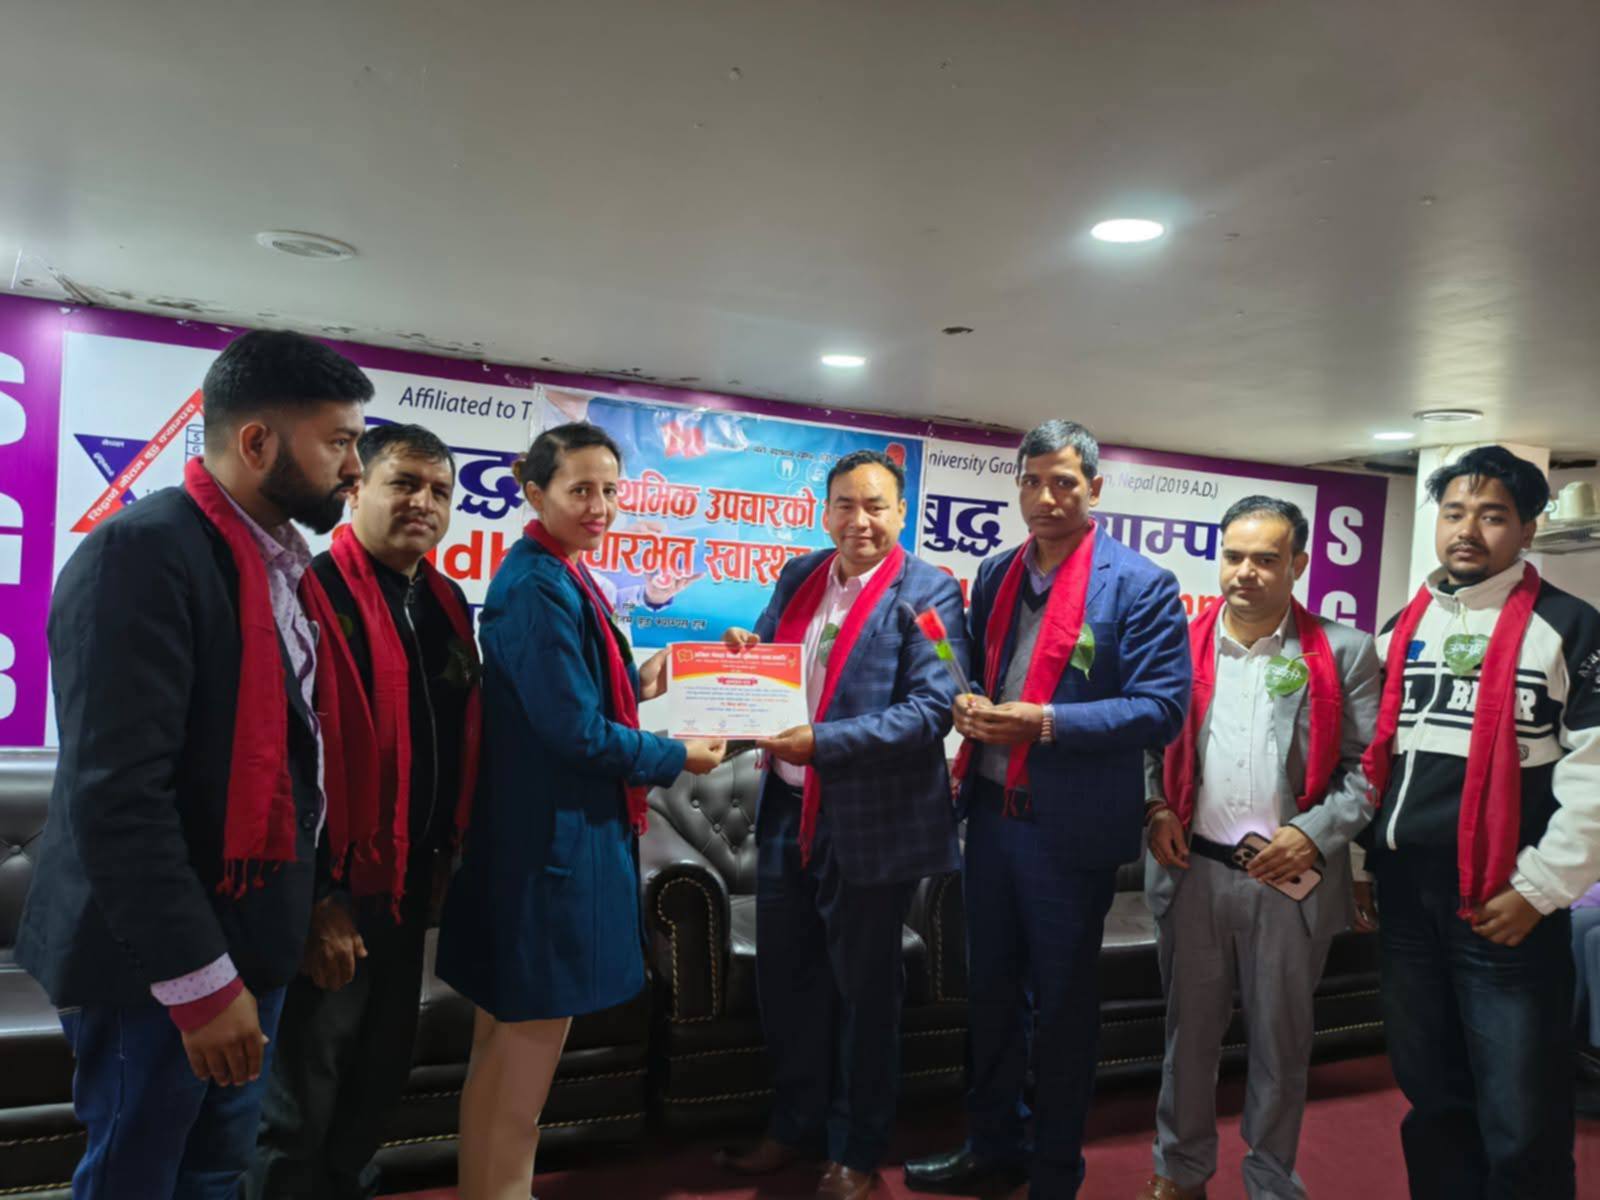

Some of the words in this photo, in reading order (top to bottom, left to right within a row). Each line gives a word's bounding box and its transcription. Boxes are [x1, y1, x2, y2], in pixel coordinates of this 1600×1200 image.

[399, 386, 492, 416] Affiliated
[496, 396, 516, 419] to
[928, 450, 987, 476] niversity
[617, 469, 701, 519] थमिक
[705, 487, 817, 529] उपचारको
